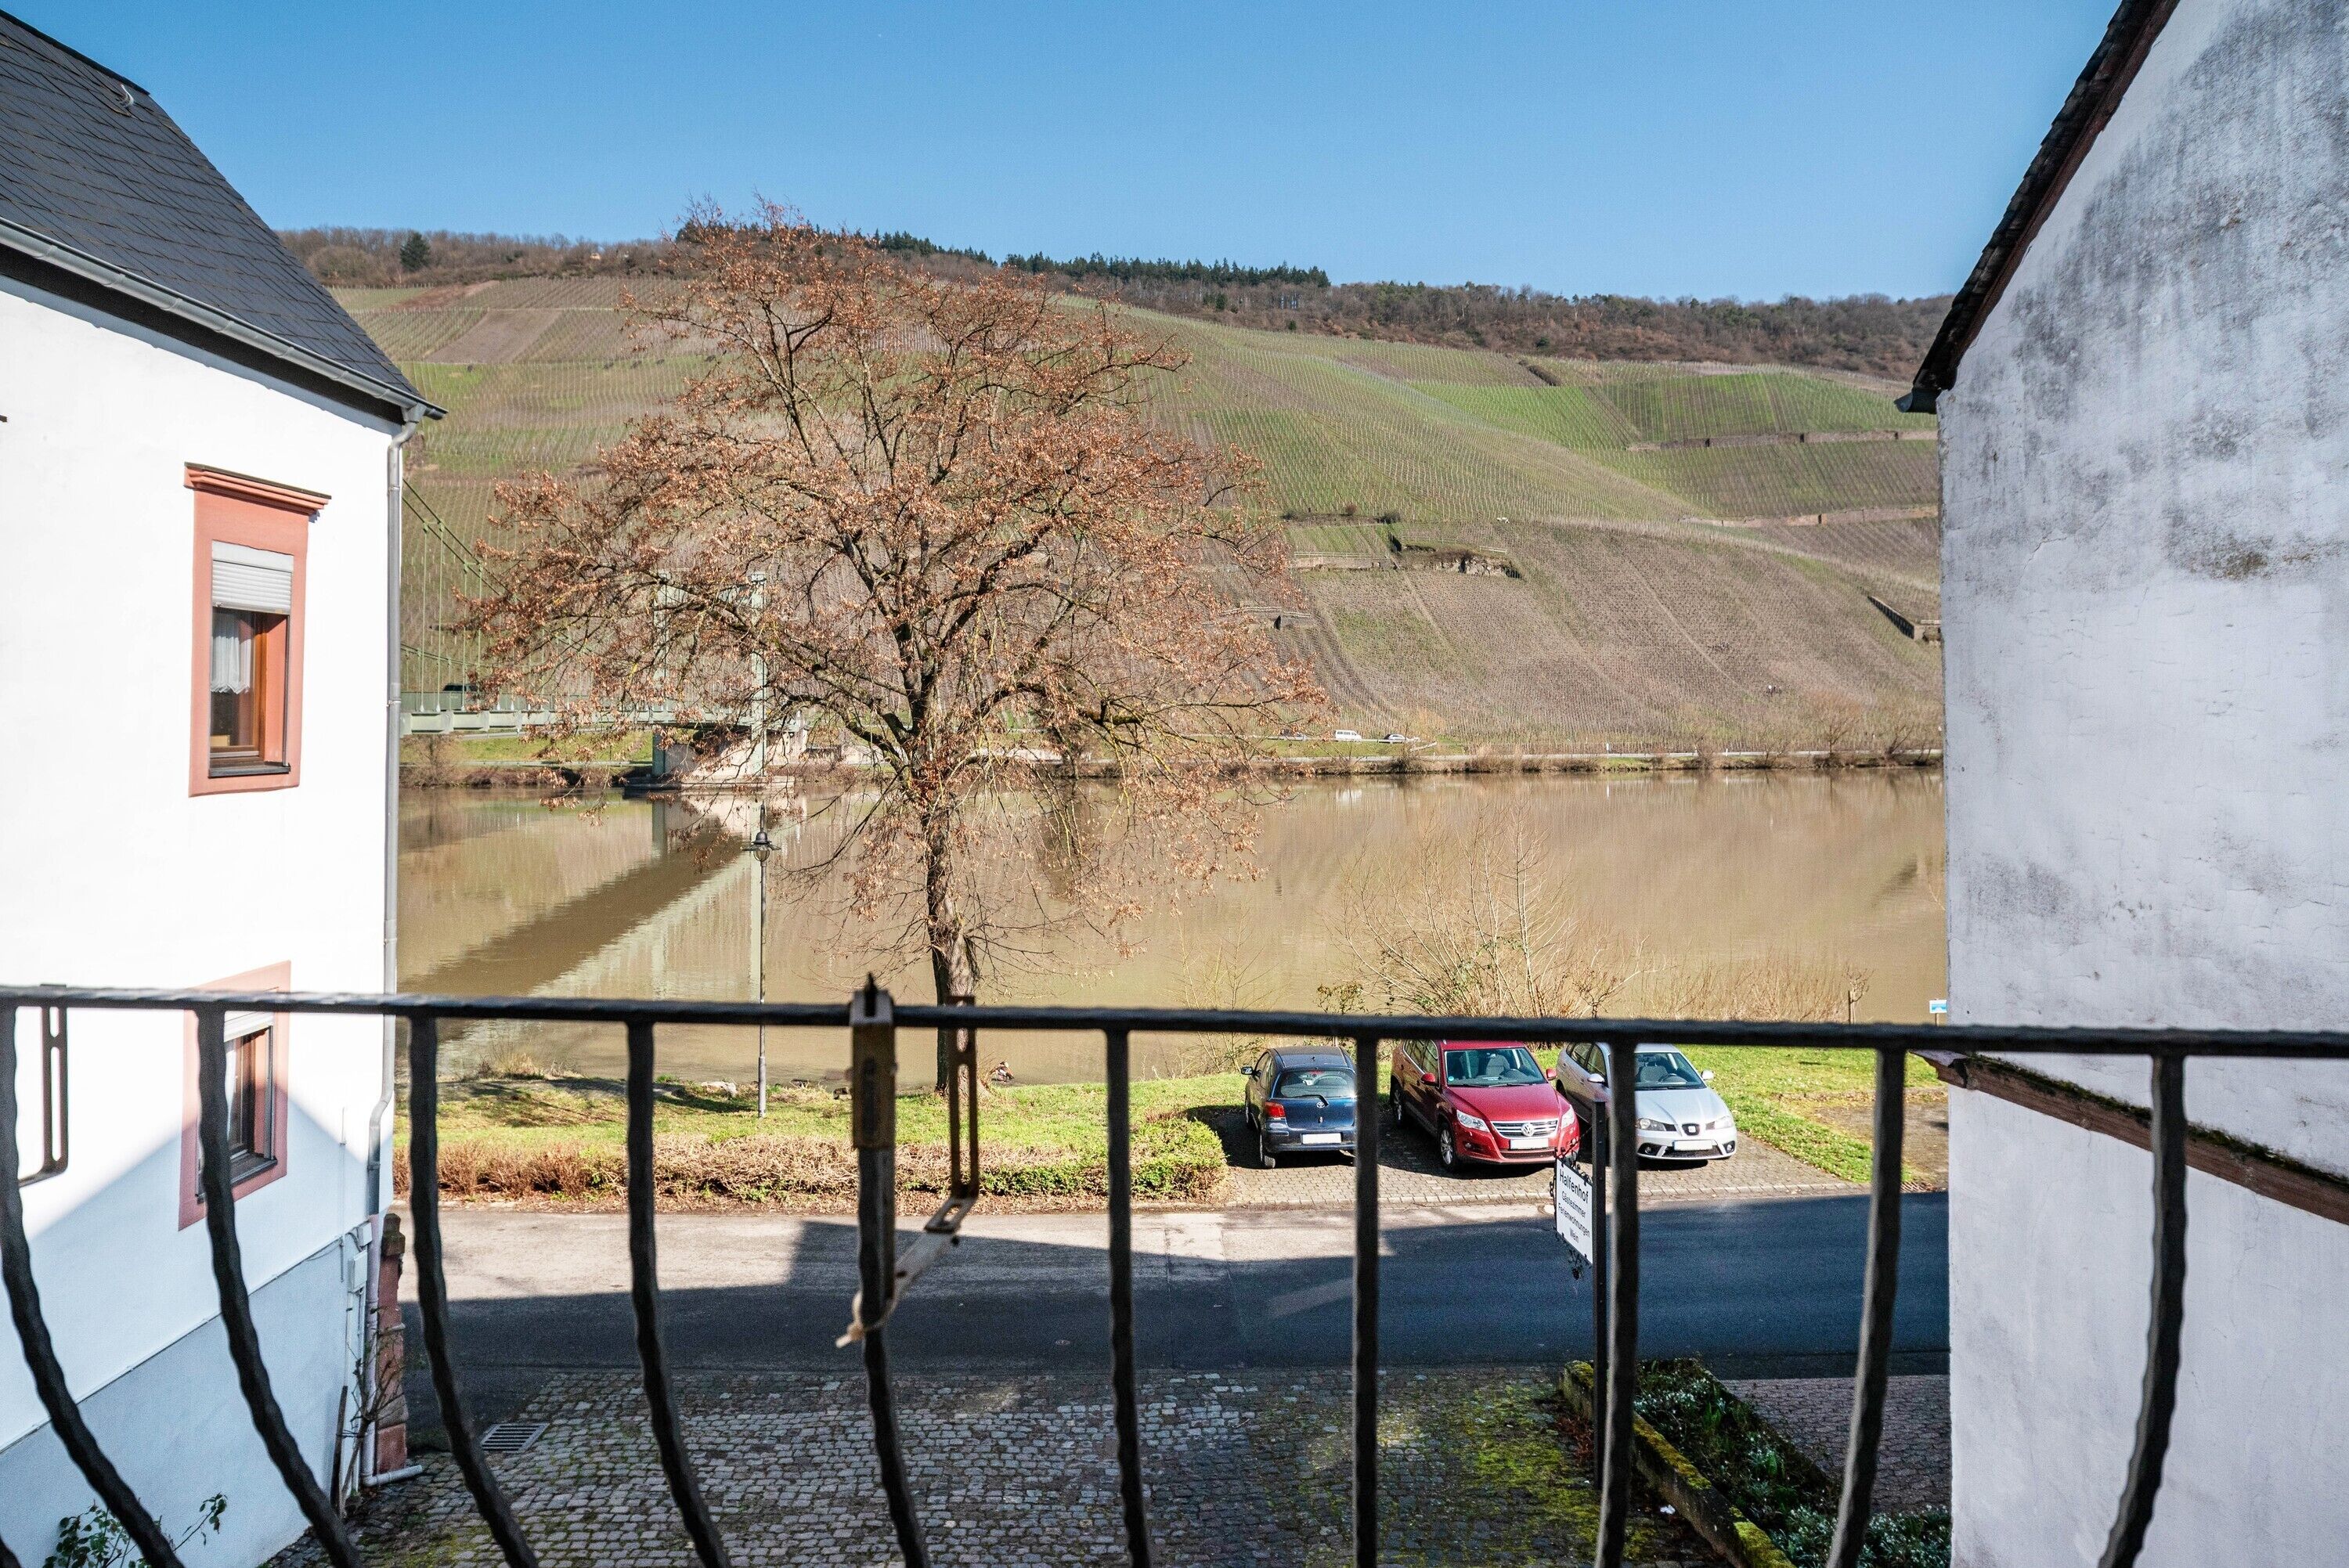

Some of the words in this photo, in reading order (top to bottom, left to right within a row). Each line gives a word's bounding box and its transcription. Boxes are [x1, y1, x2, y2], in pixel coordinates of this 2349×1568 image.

[1560, 1169, 1589, 1203] Halfenhof
[1561, 1191, 1586, 1218] Gästezimmer
[1558, 1202, 1590, 1238] Ferienwohnungen
[1569, 1227, 1579, 1243] Wein
